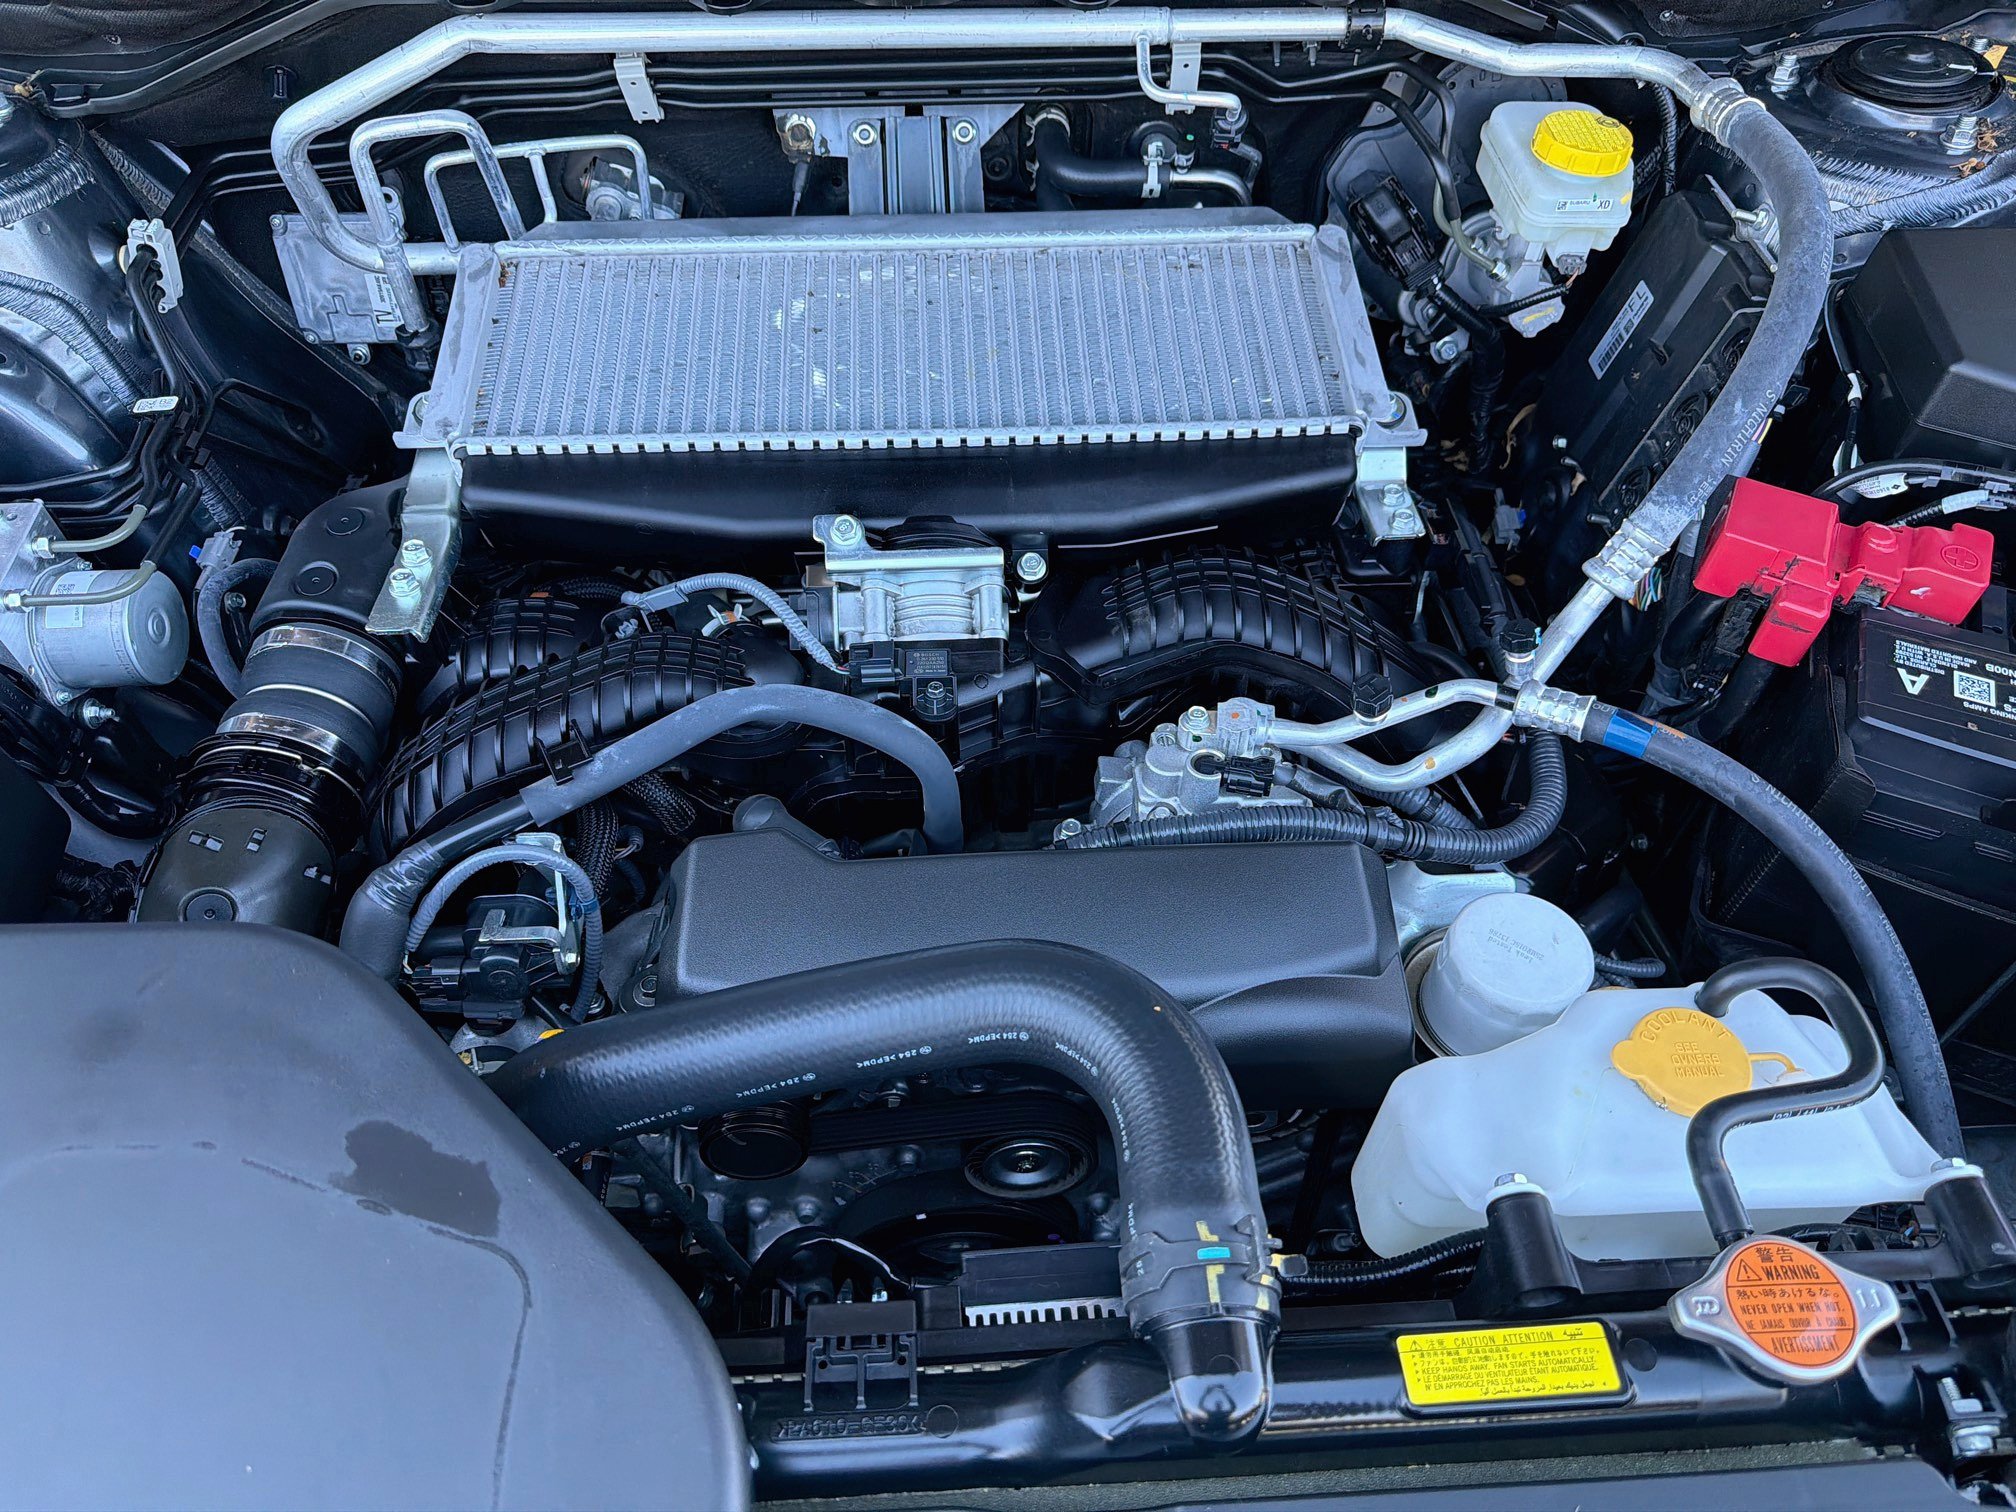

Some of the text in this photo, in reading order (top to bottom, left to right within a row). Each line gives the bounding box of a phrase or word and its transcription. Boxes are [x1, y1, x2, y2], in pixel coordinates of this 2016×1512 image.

[1896, 640, 1930, 653] MATERIALS
[1907, 647, 1923, 655] WITH
[1931, 649, 1963, 661] IMPORTED
[1905, 661, 1945, 675] DISTRIBUTED
[1952, 659, 1970, 668] MADE
[1897, 667, 1930, 695] A
[1963, 701, 1988, 713] AMPS
[1641, 1011, 1732, 1043] COOLANT
[1674, 1041, 1701, 1053] SEE
[1675, 1066, 1725, 1079] MANUAL
[1756, 1247, 1794, 1263] 警告
[1761, 1264, 1820, 1281] WARNING
[1740, 1301, 1845, 1315] NEVER OPEN WHEN HOT.
[1745, 1320, 1756, 1330] NE
[1759, 1319, 1785, 1330] JAMAIS
[1789, 1318, 1812, 1328] OUVRIR
[1425, 1338, 1447, 1350] 注意
[1453, 1331, 1554, 1348] CAUTION ATTENTION
[1771, 1335, 1840, 1354] AVERTISSMENT
[1422, 1366, 1441, 1375] KEEP
[1443, 1365, 1468, 1373] HANDS
[1494, 1362, 1508, 1370] FAN
[1510, 1360, 1536, 1369] STARTS
[1539, 1356, 1597, 1367] AUTOMATICALLY.
[1423, 1375, 1432, 1383] LE
[1474, 1371, 1483, 1379] DU
[1486, 1368, 1528, 1378] VENTILATEUR
[1551, 1363, 1598, 1374] AUTOMATIQUE.
[1434, 1383, 1443, 1391] EN
[1445, 1380, 1485, 1389] APPROCHEZ
[1487, 1379, 1500, 1387] PAS
[1501, 1377, 1514, 1386] LES
[1515, 1376, 1540, 1384] MAINS.
